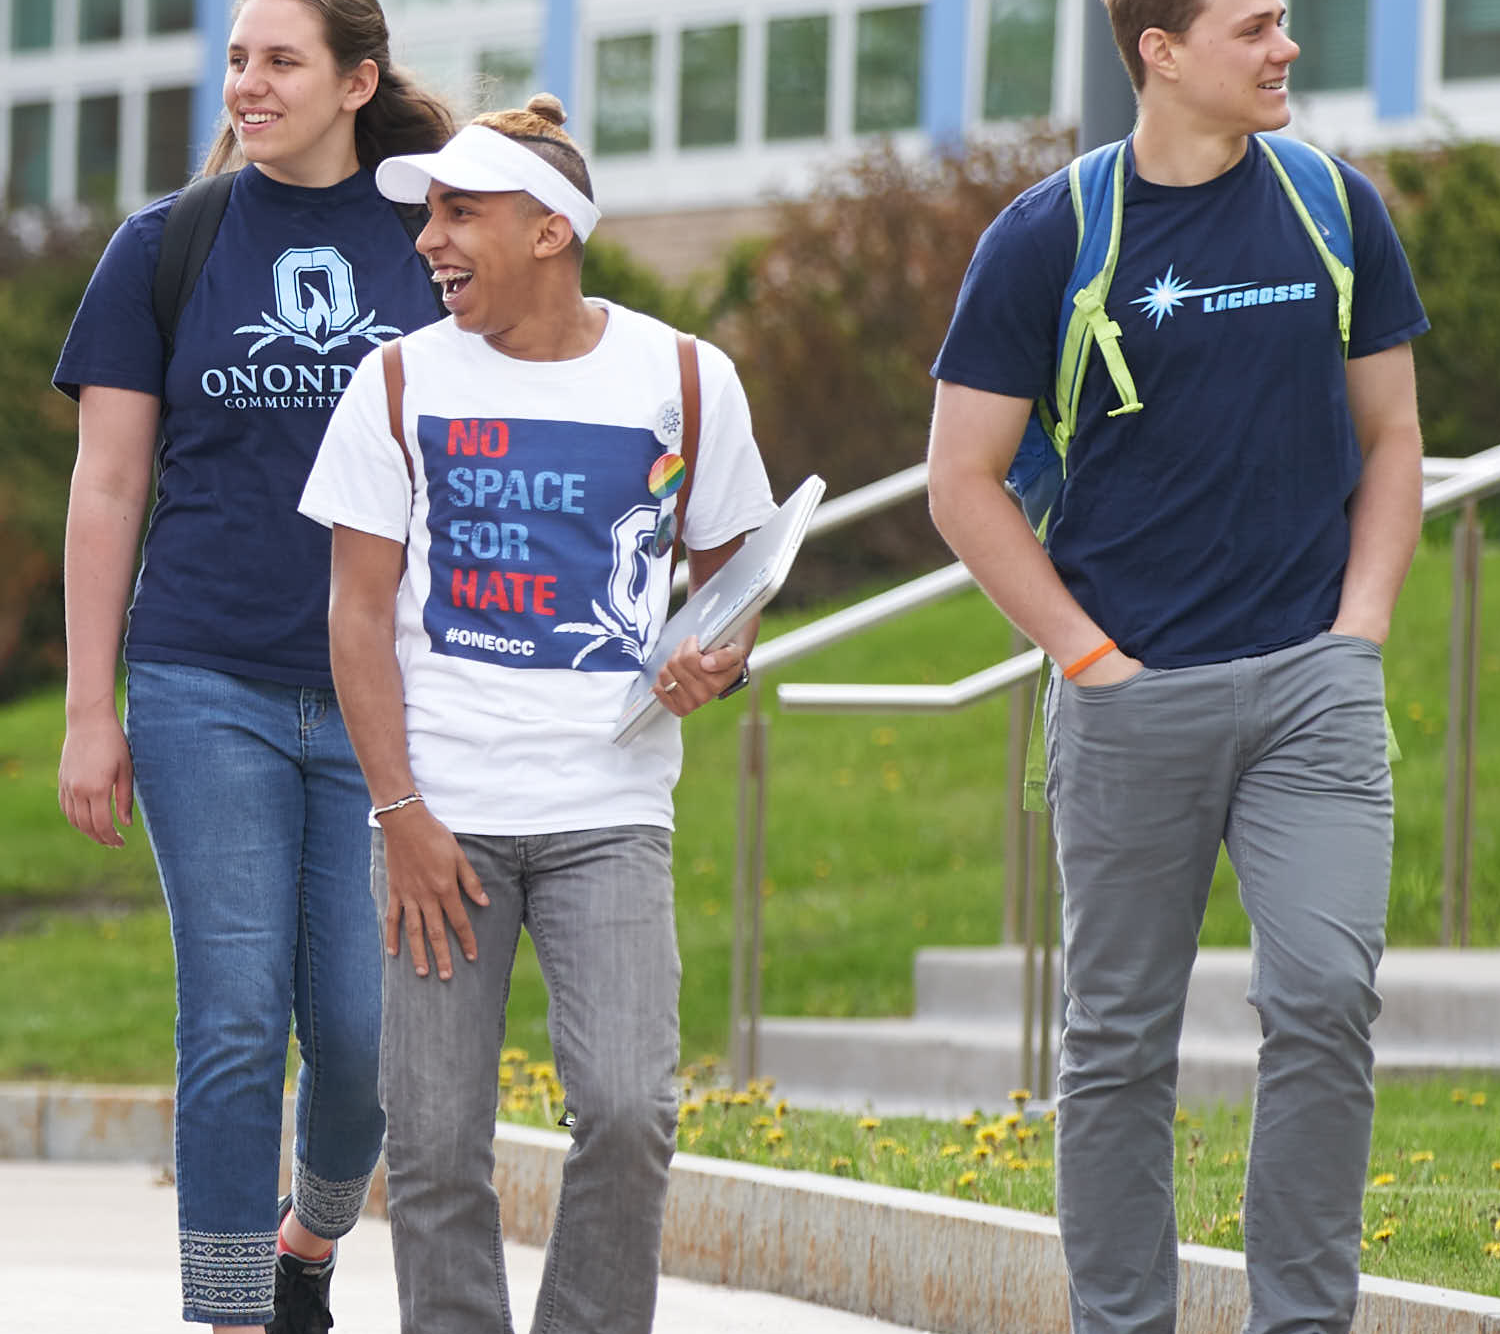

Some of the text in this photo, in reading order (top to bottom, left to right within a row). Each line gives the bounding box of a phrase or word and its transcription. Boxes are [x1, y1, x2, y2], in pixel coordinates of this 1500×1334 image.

[1203, 282, 1316, 313] LACROSSE
[201, 364, 357, 397] ONOND
[224, 396, 337, 409] COMMUNITY
[447, 419, 509, 458] NO
[447, 467, 586, 514] SPACE
[450, 520, 530, 561] FOR
[451, 569, 557, 616] HATE
[445, 627, 535, 657] #ONEOCC
